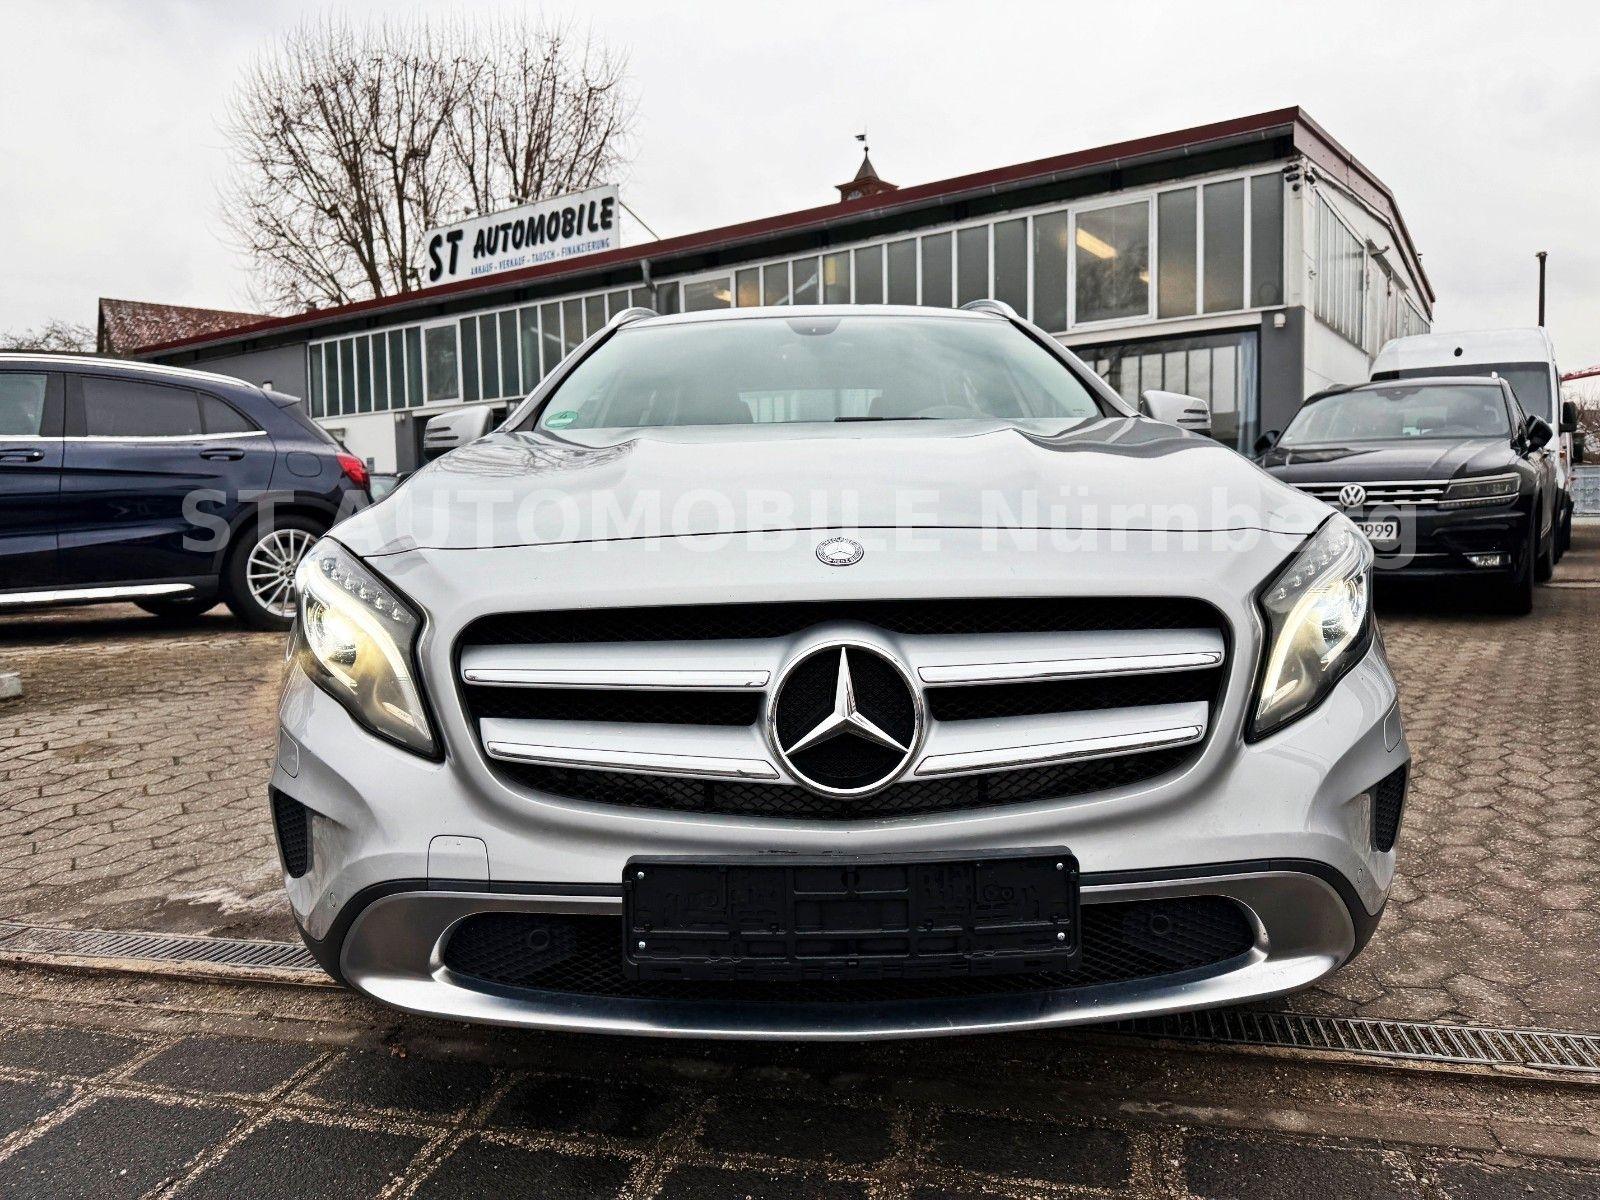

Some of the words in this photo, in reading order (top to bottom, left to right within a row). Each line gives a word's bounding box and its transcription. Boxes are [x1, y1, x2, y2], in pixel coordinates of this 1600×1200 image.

[429, 229, 463, 282] ST
[473, 196, 614, 259] AUTOMOBILE
[499, 255, 526, 270] VERKAUF
[532, 249, 555, 263] TAUSCH
[562, 238, 610, 257] FINANZIERUNG
